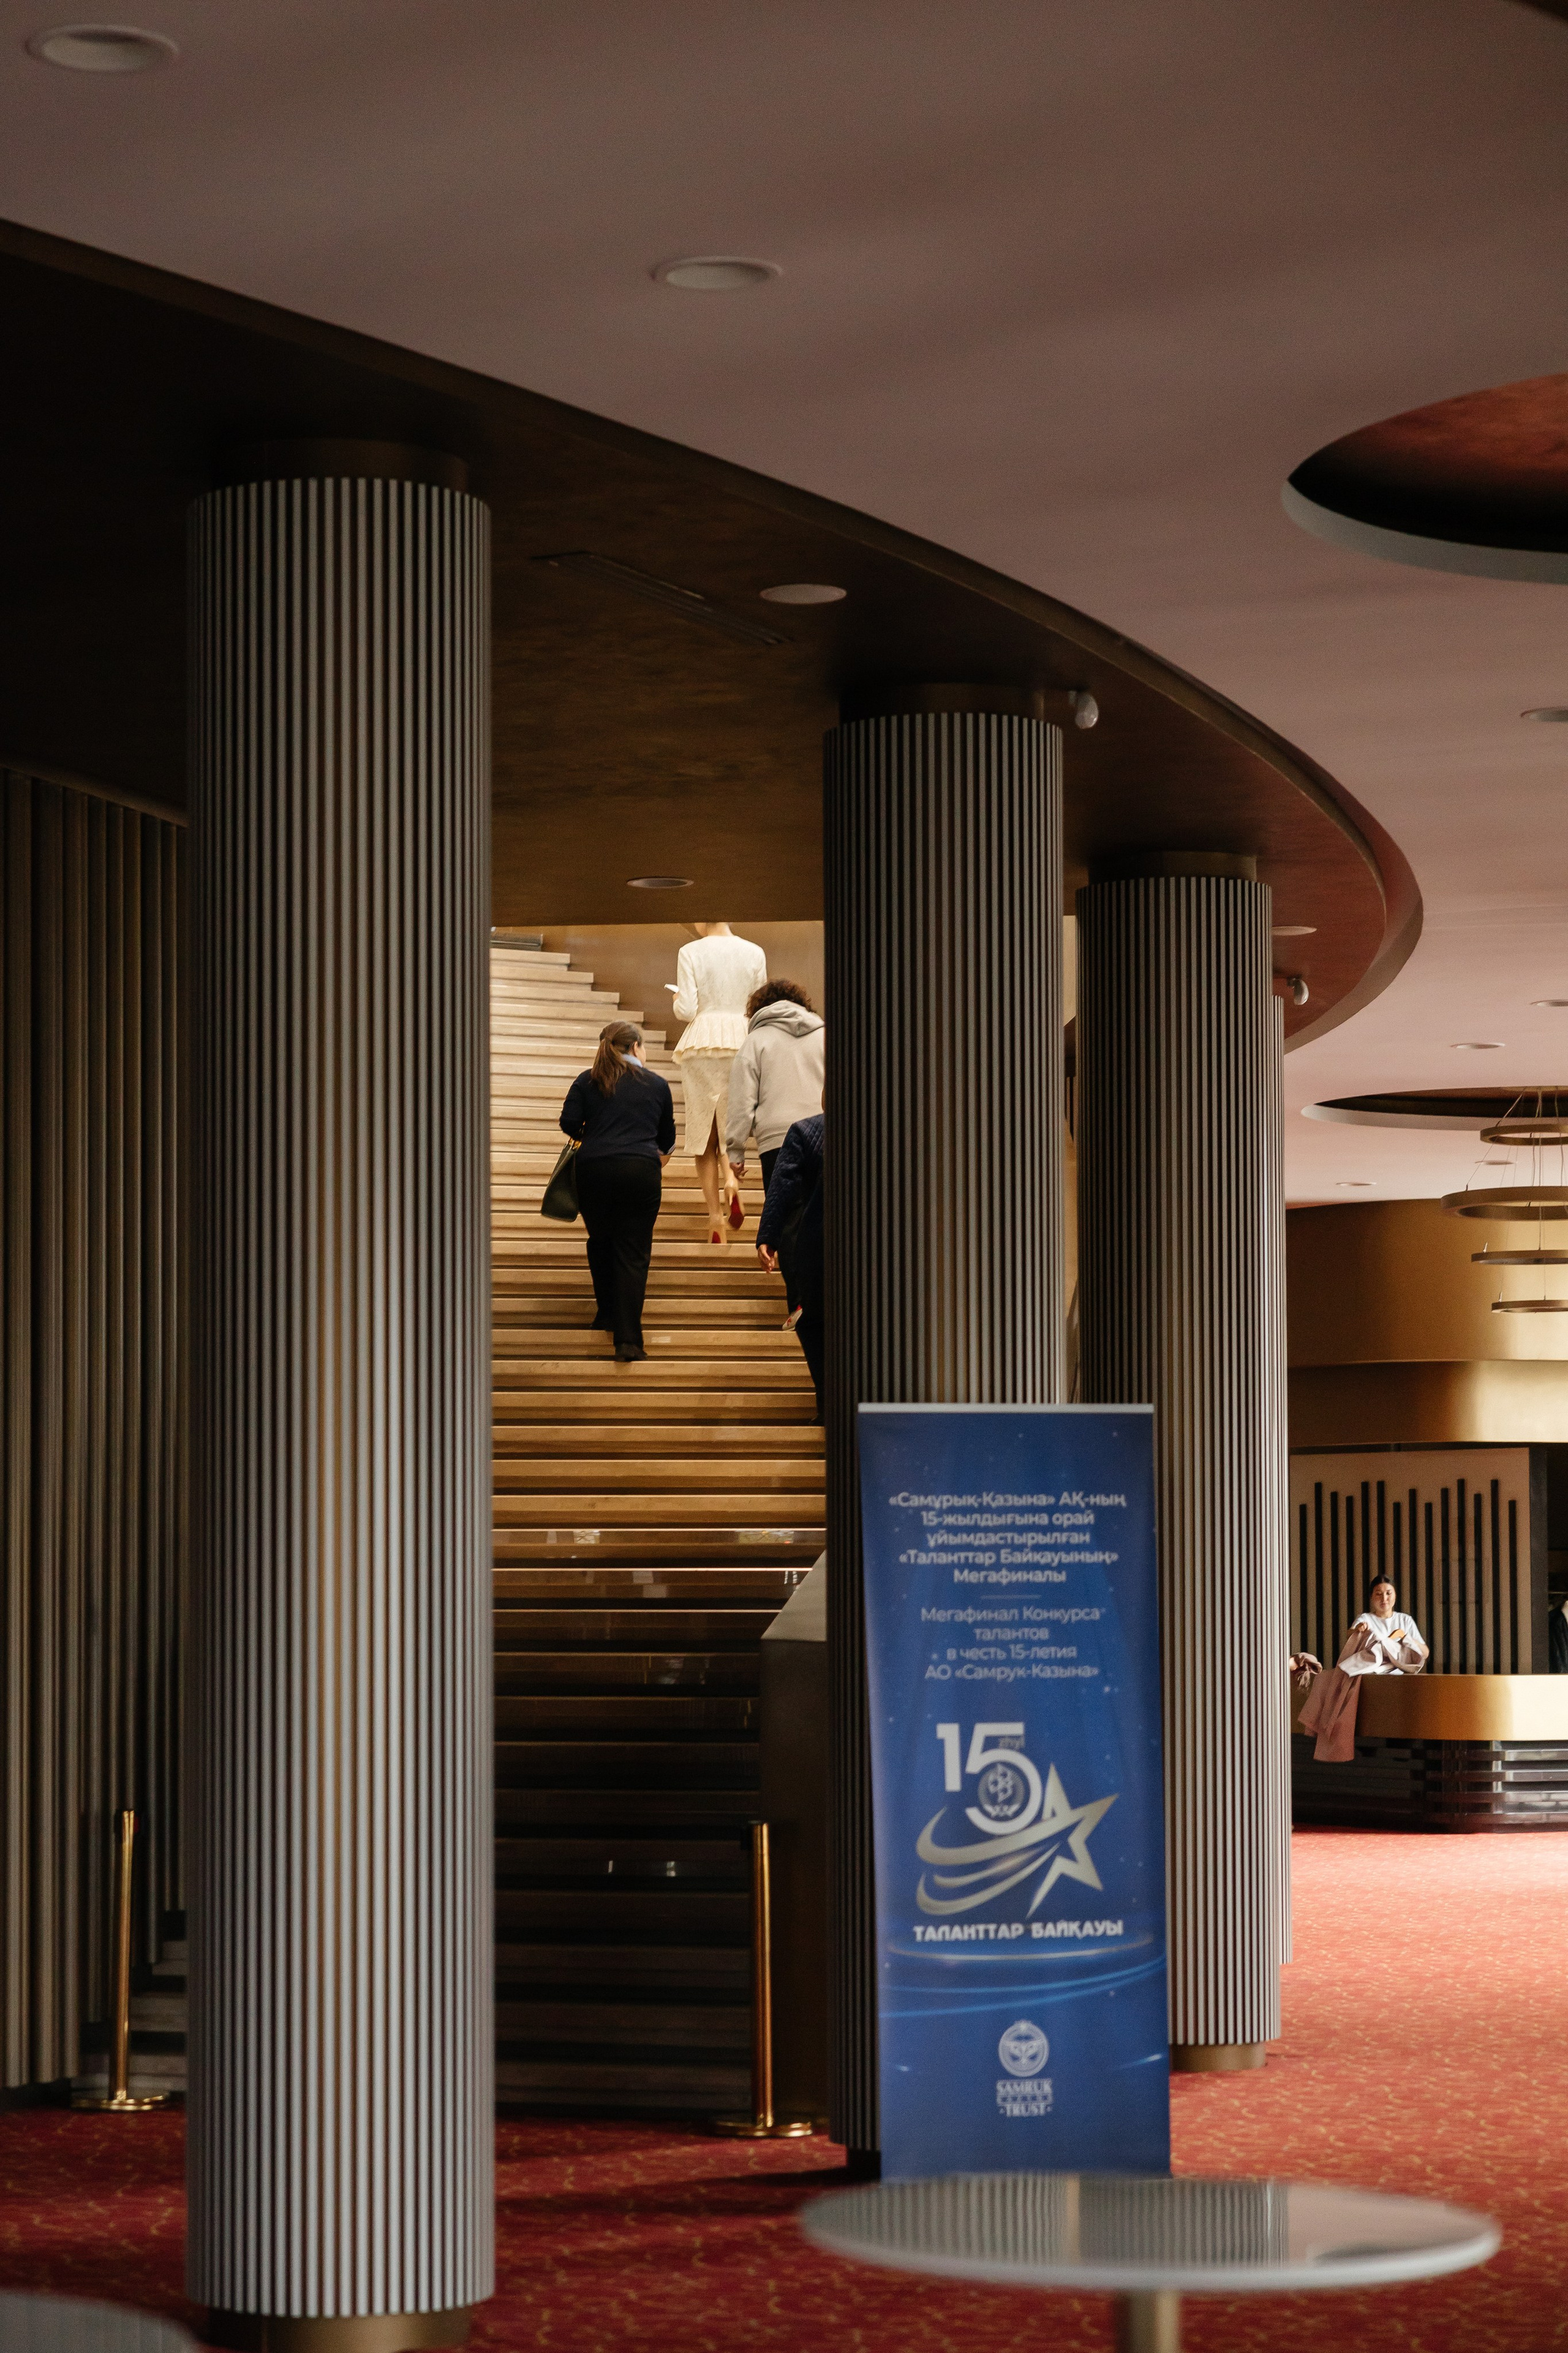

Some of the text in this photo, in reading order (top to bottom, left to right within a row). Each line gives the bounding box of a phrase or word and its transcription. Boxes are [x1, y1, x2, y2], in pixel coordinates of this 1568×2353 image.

[888, 1491, 1127, 1509] «Самұрық-Қазына» АҚ-ның
[921, 1509, 1095, 1528] 15-жылдығына орай
[925, 1529, 1091, 1548] ұйымдастырылған
[899, 1547, 1120, 1567] «Таланттар Байқауының»
[953, 1567, 1067, 1585] Мегафиналы
[921, 1606, 1101, 1624] Мегафинал Конкурса
[973, 1627, 1050, 1641] талантов
[946, 1643, 1077, 1660] в честь 15-летия
[924, 1663, 1099, 1682] АО «Самрук-Казына»
[937, 1722, 1042, 1835] 15
[913, 1920, 1124, 1942] ТАЛАНТТАР БАЙҚАУЫ
[997, 2079, 1052, 2094] SAMRUK
